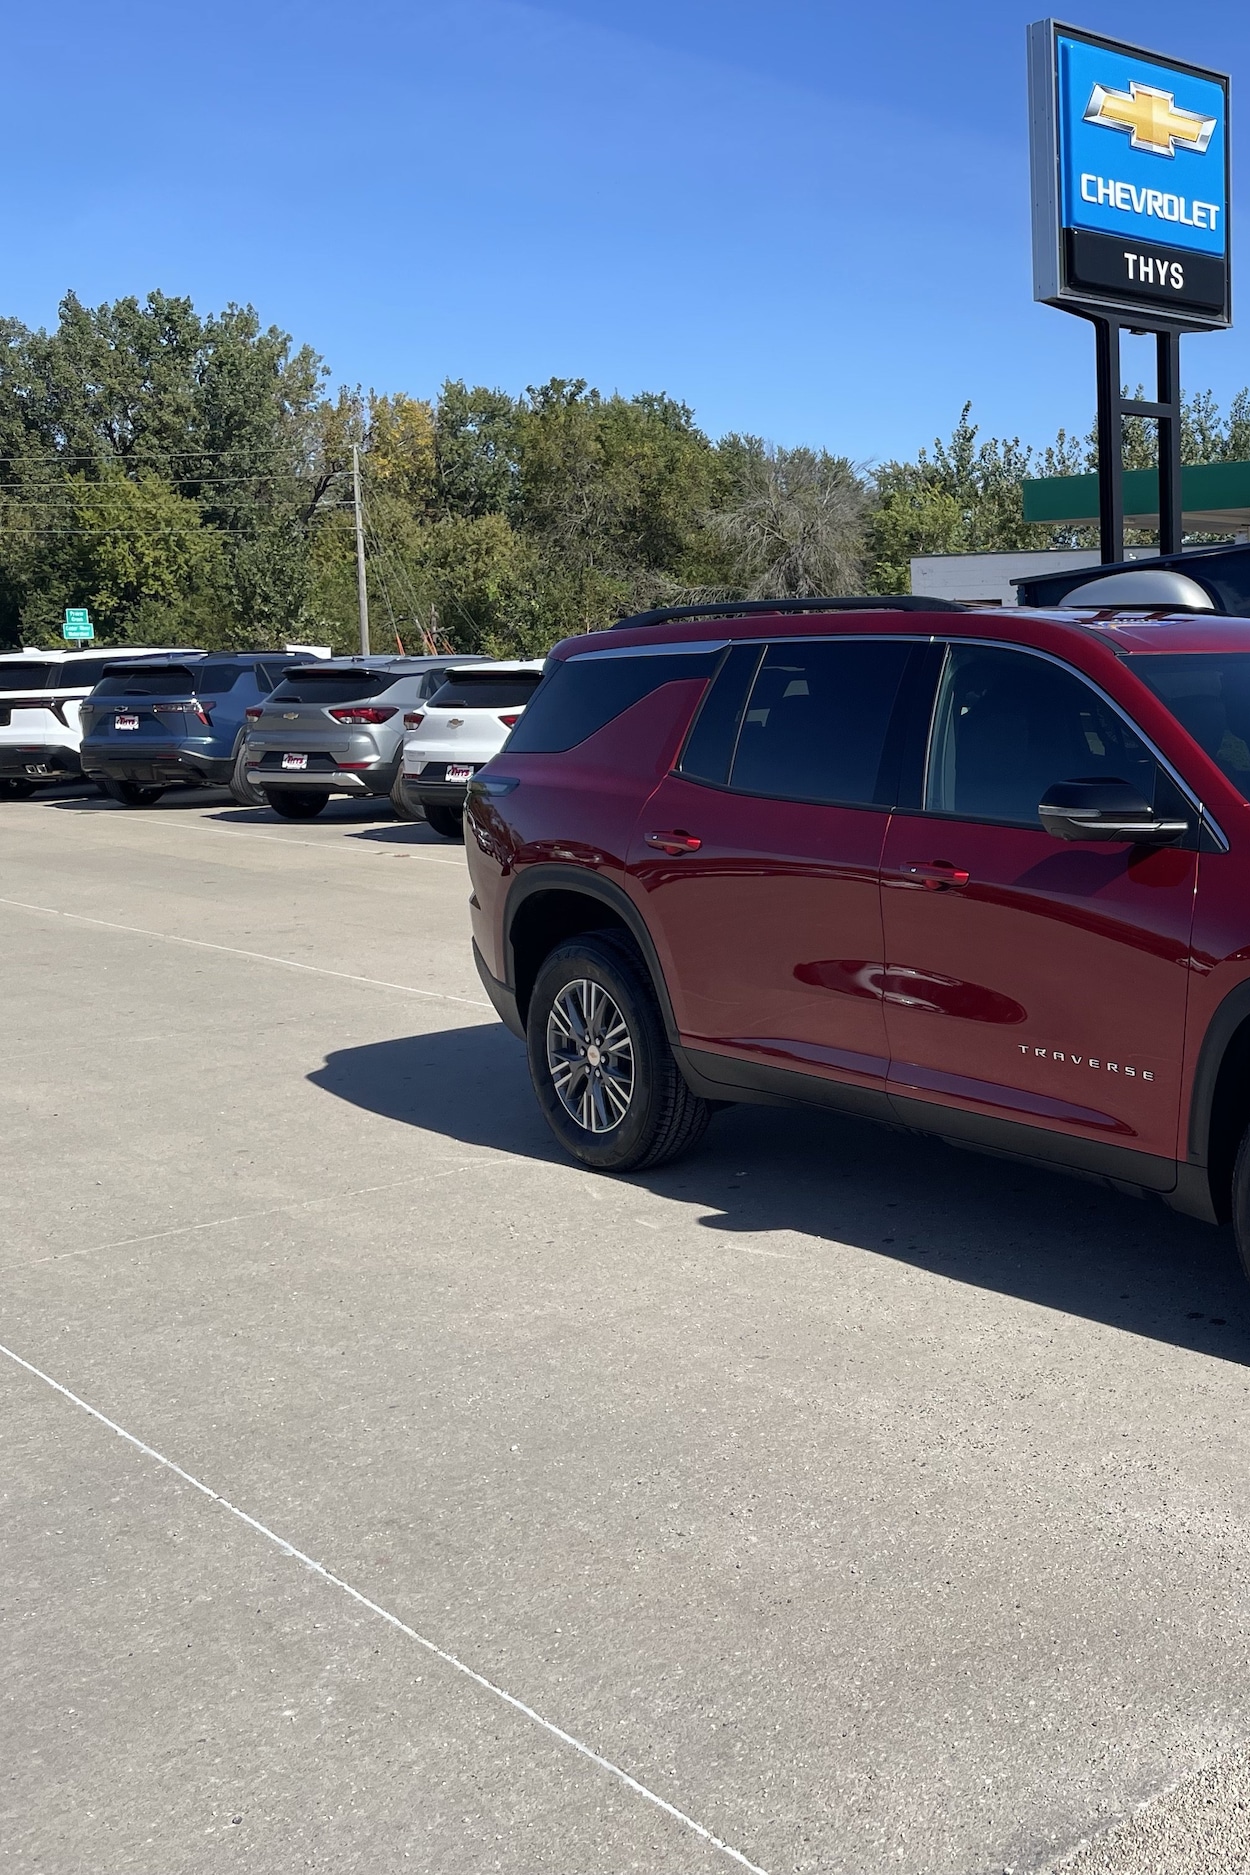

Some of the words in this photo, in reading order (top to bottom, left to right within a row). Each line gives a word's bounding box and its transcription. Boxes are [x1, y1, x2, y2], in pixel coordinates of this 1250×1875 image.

[1080, 173, 1220, 231] CHEVROLET
[1124, 252, 1185, 290] THYS
[451, 765, 470, 777] THYS
[1018, 1044, 1155, 1081] TRAVERSE
